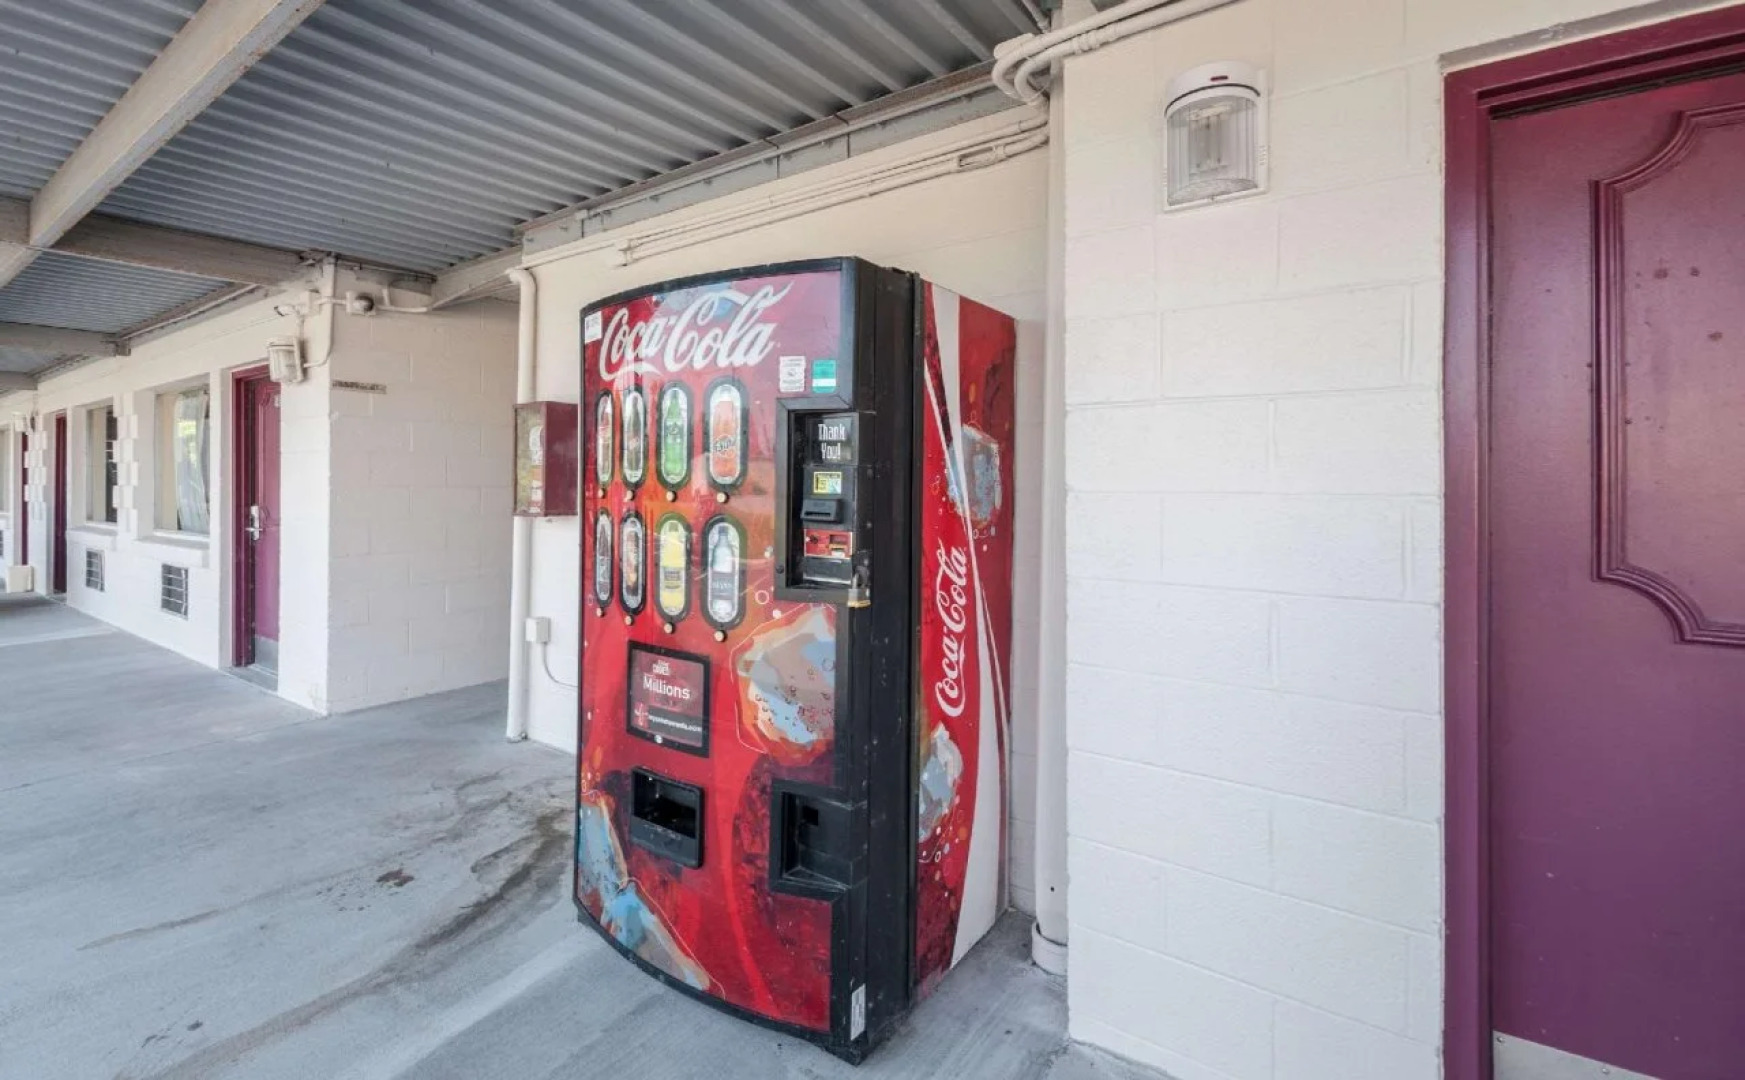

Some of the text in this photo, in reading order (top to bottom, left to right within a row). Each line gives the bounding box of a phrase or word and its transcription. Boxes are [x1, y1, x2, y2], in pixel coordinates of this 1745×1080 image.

[600, 282, 792, 380] Coca-Cola
[818, 423, 846, 441] Thank
[821, 442, 841, 459] You!
[935, 537, 967, 717] Coca-Cola
[643, 675, 691, 700] Millions
